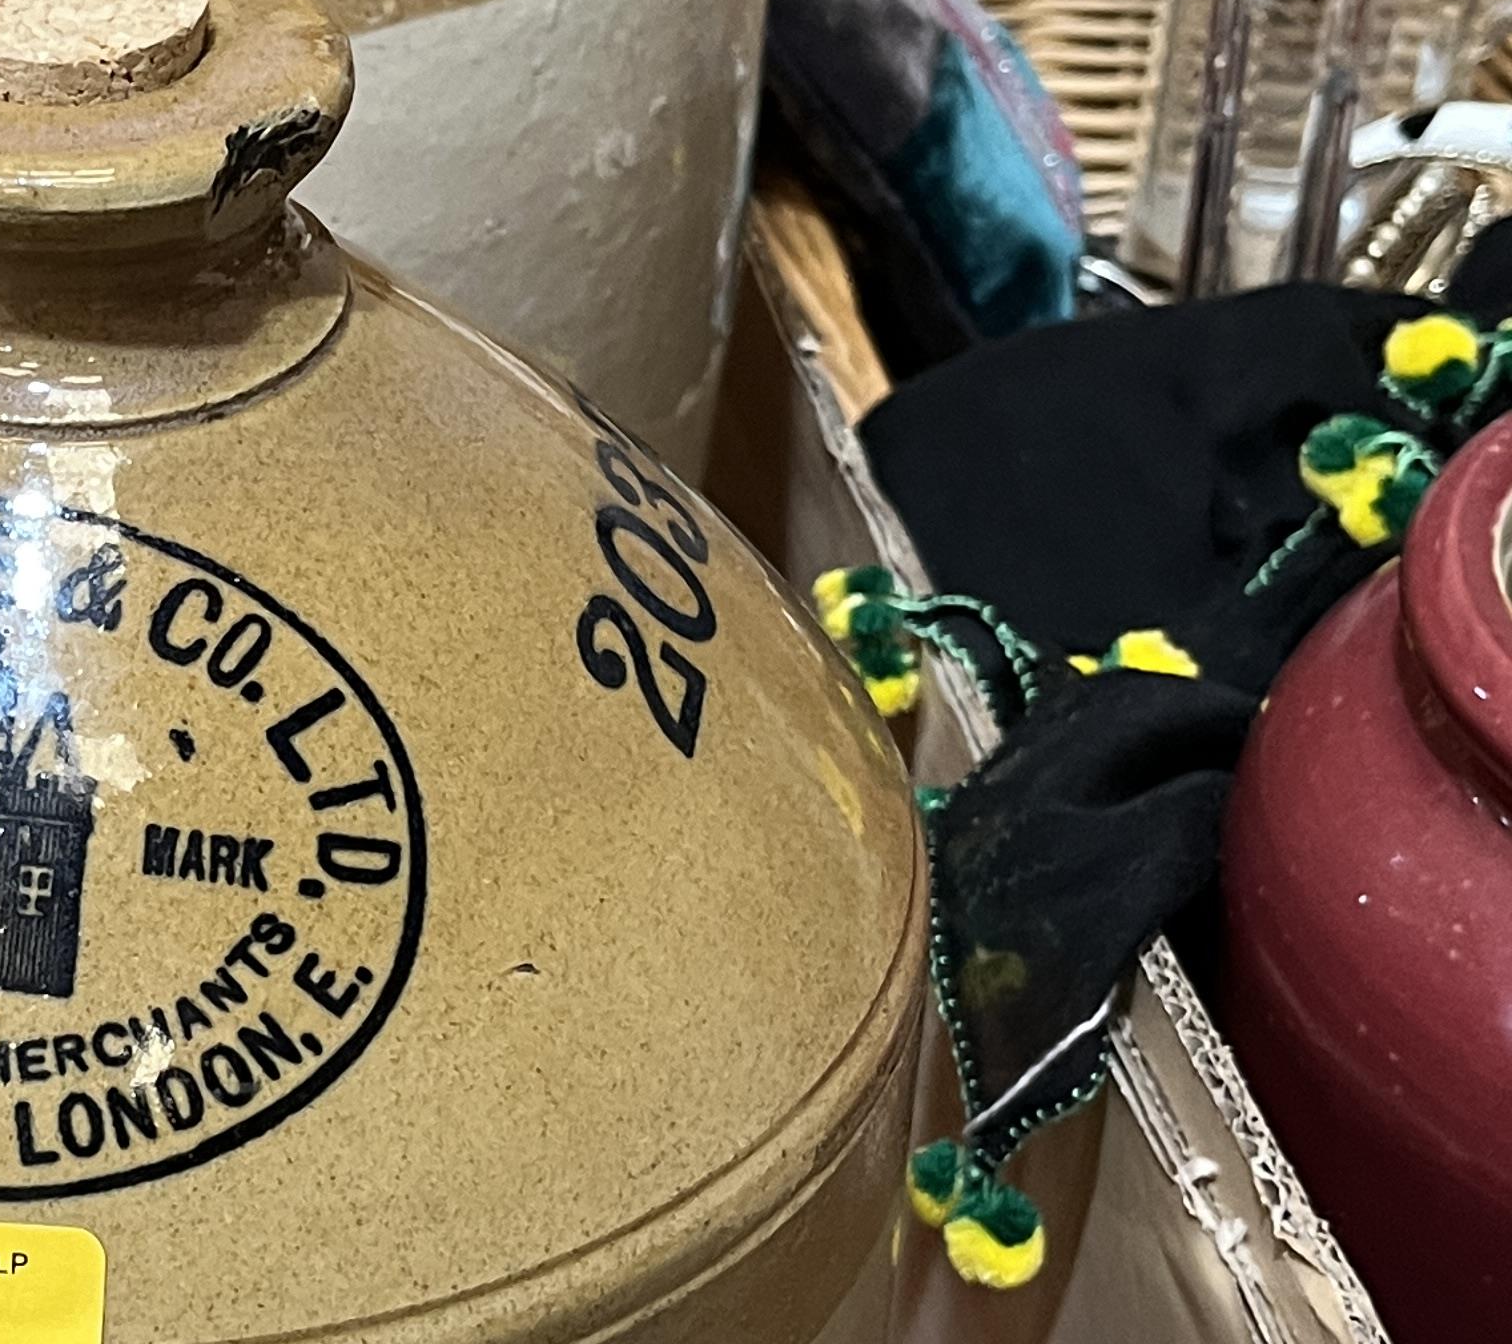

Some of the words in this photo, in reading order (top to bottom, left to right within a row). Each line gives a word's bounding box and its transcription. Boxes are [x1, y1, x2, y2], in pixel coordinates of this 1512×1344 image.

[55, 542, 127, 632] &
[148, 577, 273, 704] CO.
[265, 686, 402, 900] LTD.
[142, 822, 275, 893] MARK
[13, 1010, 324, 1168] LONDON,
[292, 951, 374, 1020] E.
